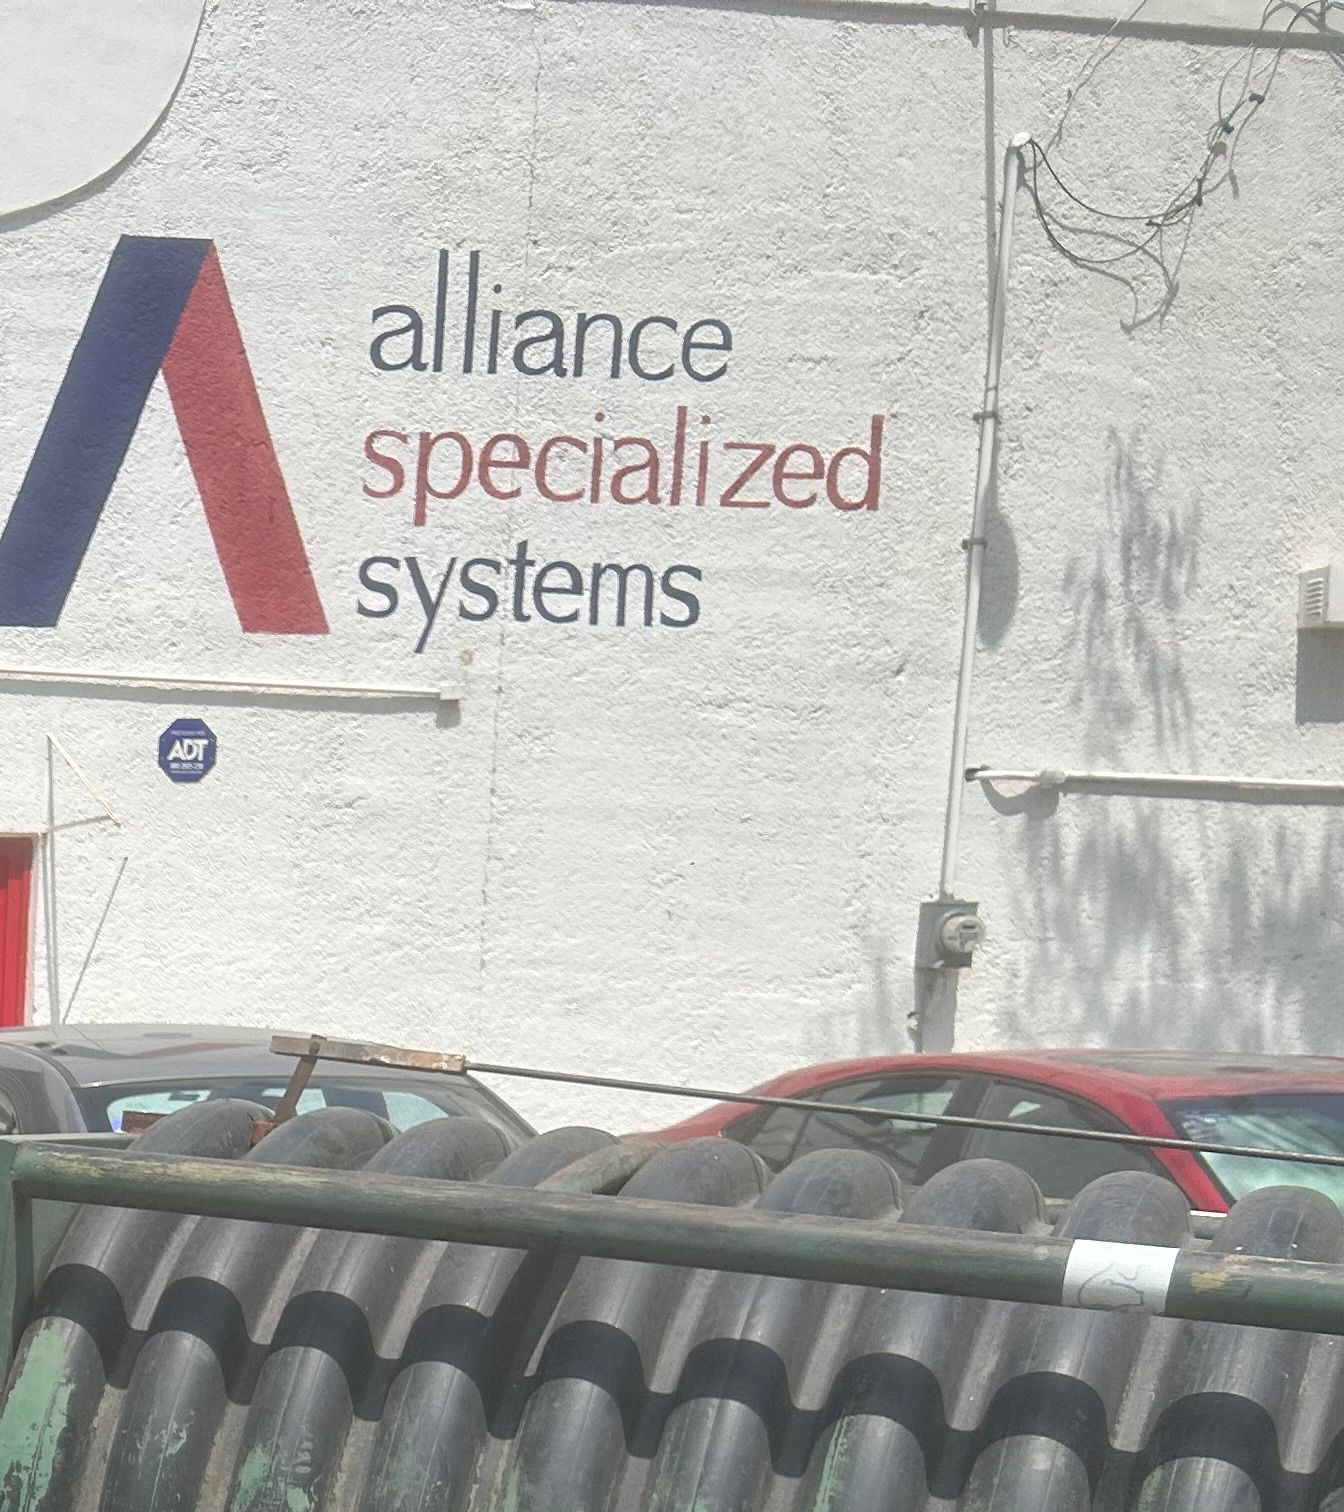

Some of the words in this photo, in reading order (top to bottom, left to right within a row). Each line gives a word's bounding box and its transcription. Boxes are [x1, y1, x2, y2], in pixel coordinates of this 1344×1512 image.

[369, 248, 734, 383] alliance
[361, 405, 886, 527] specialized
[354, 540, 703, 654] systems
[166, 738, 209, 762] ADT
